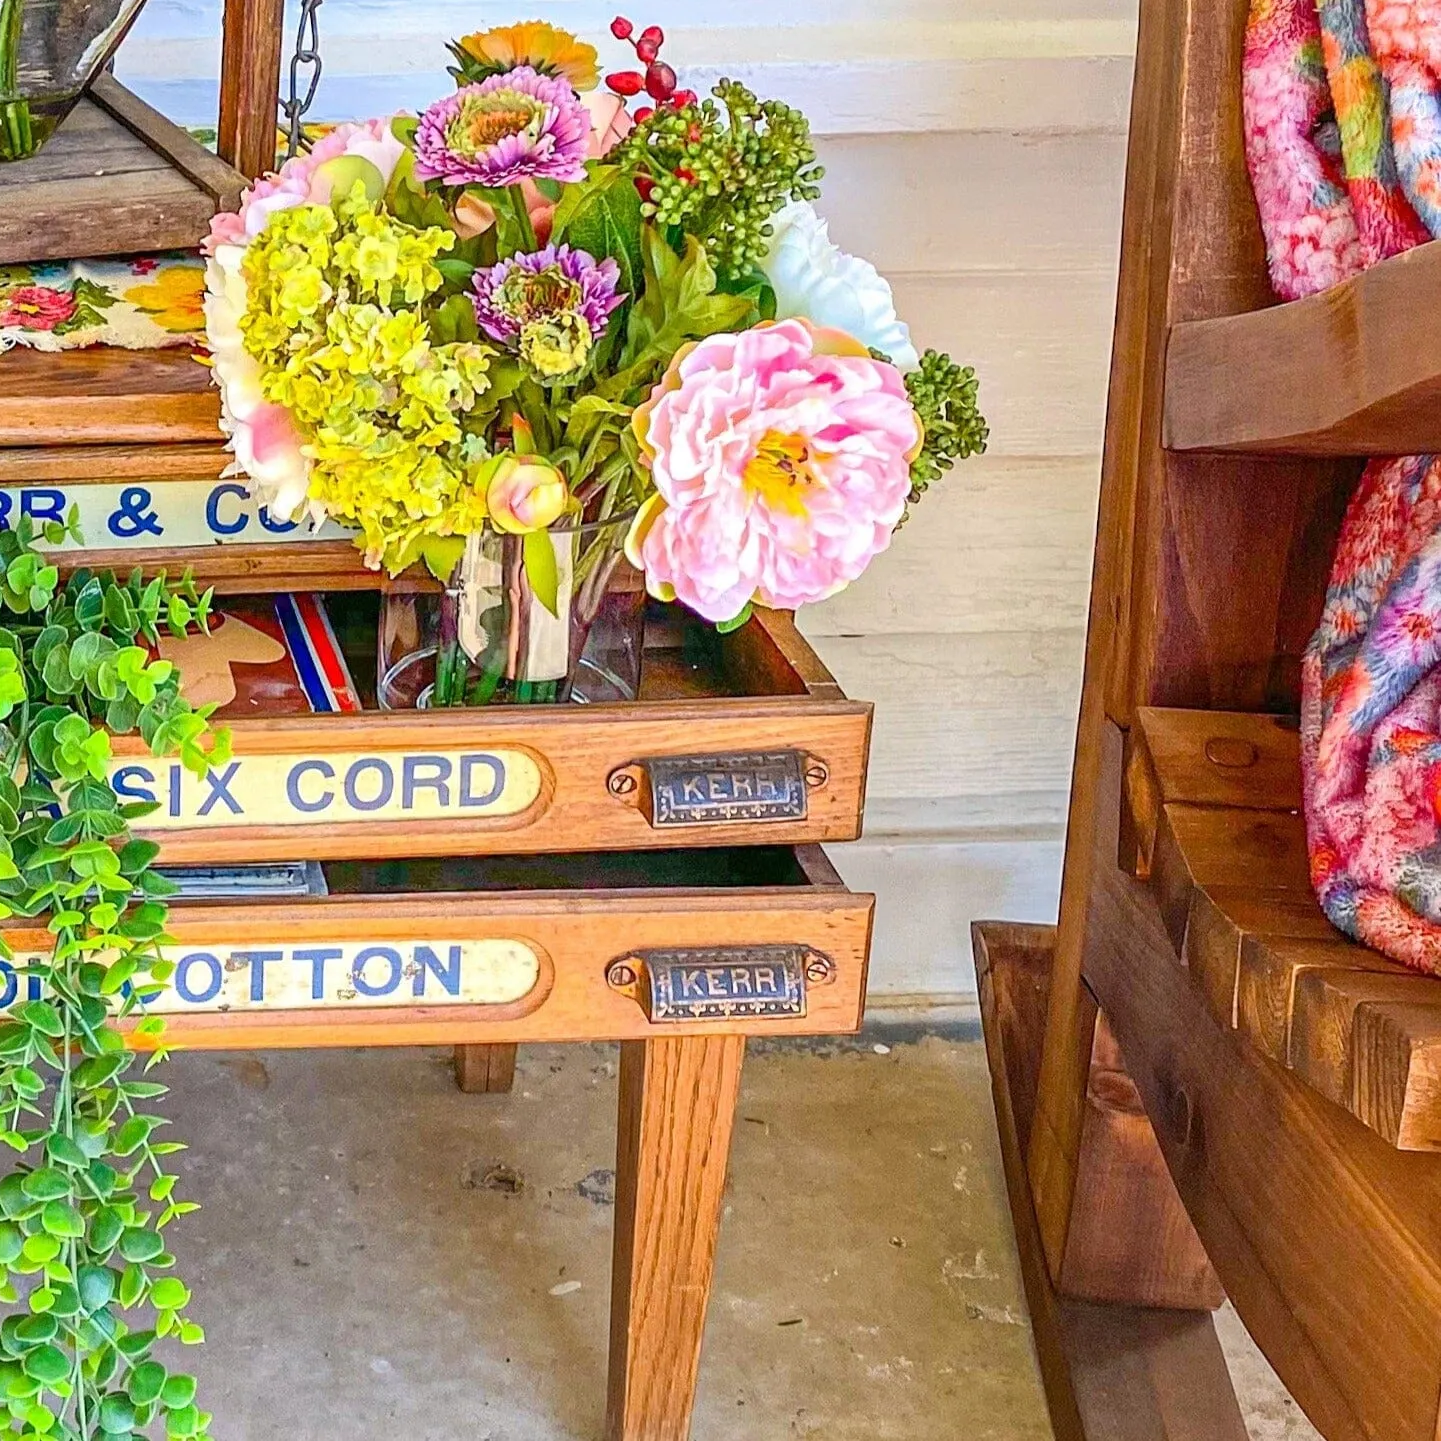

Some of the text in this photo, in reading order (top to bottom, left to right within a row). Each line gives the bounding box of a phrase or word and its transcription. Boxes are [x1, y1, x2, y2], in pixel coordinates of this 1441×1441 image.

[107, 486, 165, 538] &
[111, 761, 245, 817] SIX
[286, 753, 506, 813] CORD
[681, 772, 778, 801] KERR
[680, 967, 778, 998] KERR
